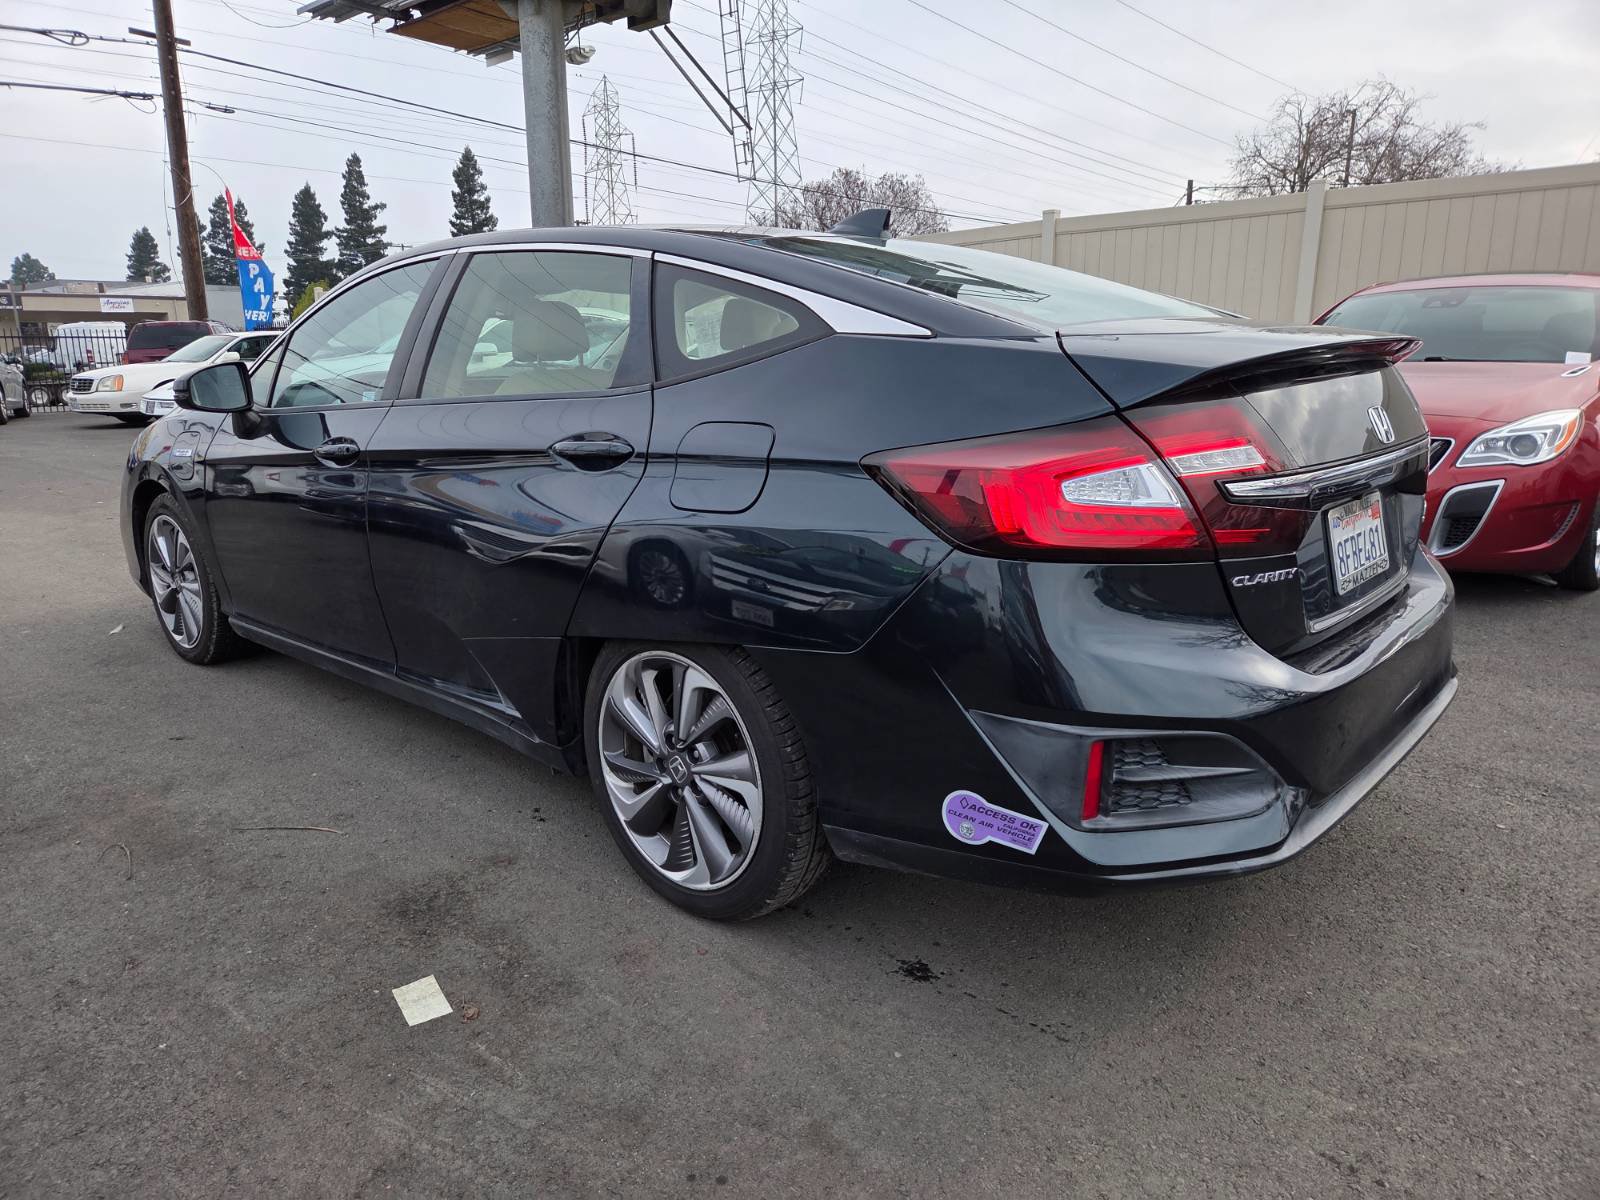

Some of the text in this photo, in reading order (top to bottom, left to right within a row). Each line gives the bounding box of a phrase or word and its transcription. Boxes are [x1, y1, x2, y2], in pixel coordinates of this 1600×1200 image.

[248, 263, 271, 310] PAY
[1337, 524, 1383, 577] 8FBE481
[1232, 567, 1298, 587] CLARITY
[947, 809, 977, 823] CLEAN
[978, 820, 994, 829] AIR
[996, 826, 1035, 843] VEHICLE
[967, 803, 1040, 832] ACCESS OK
